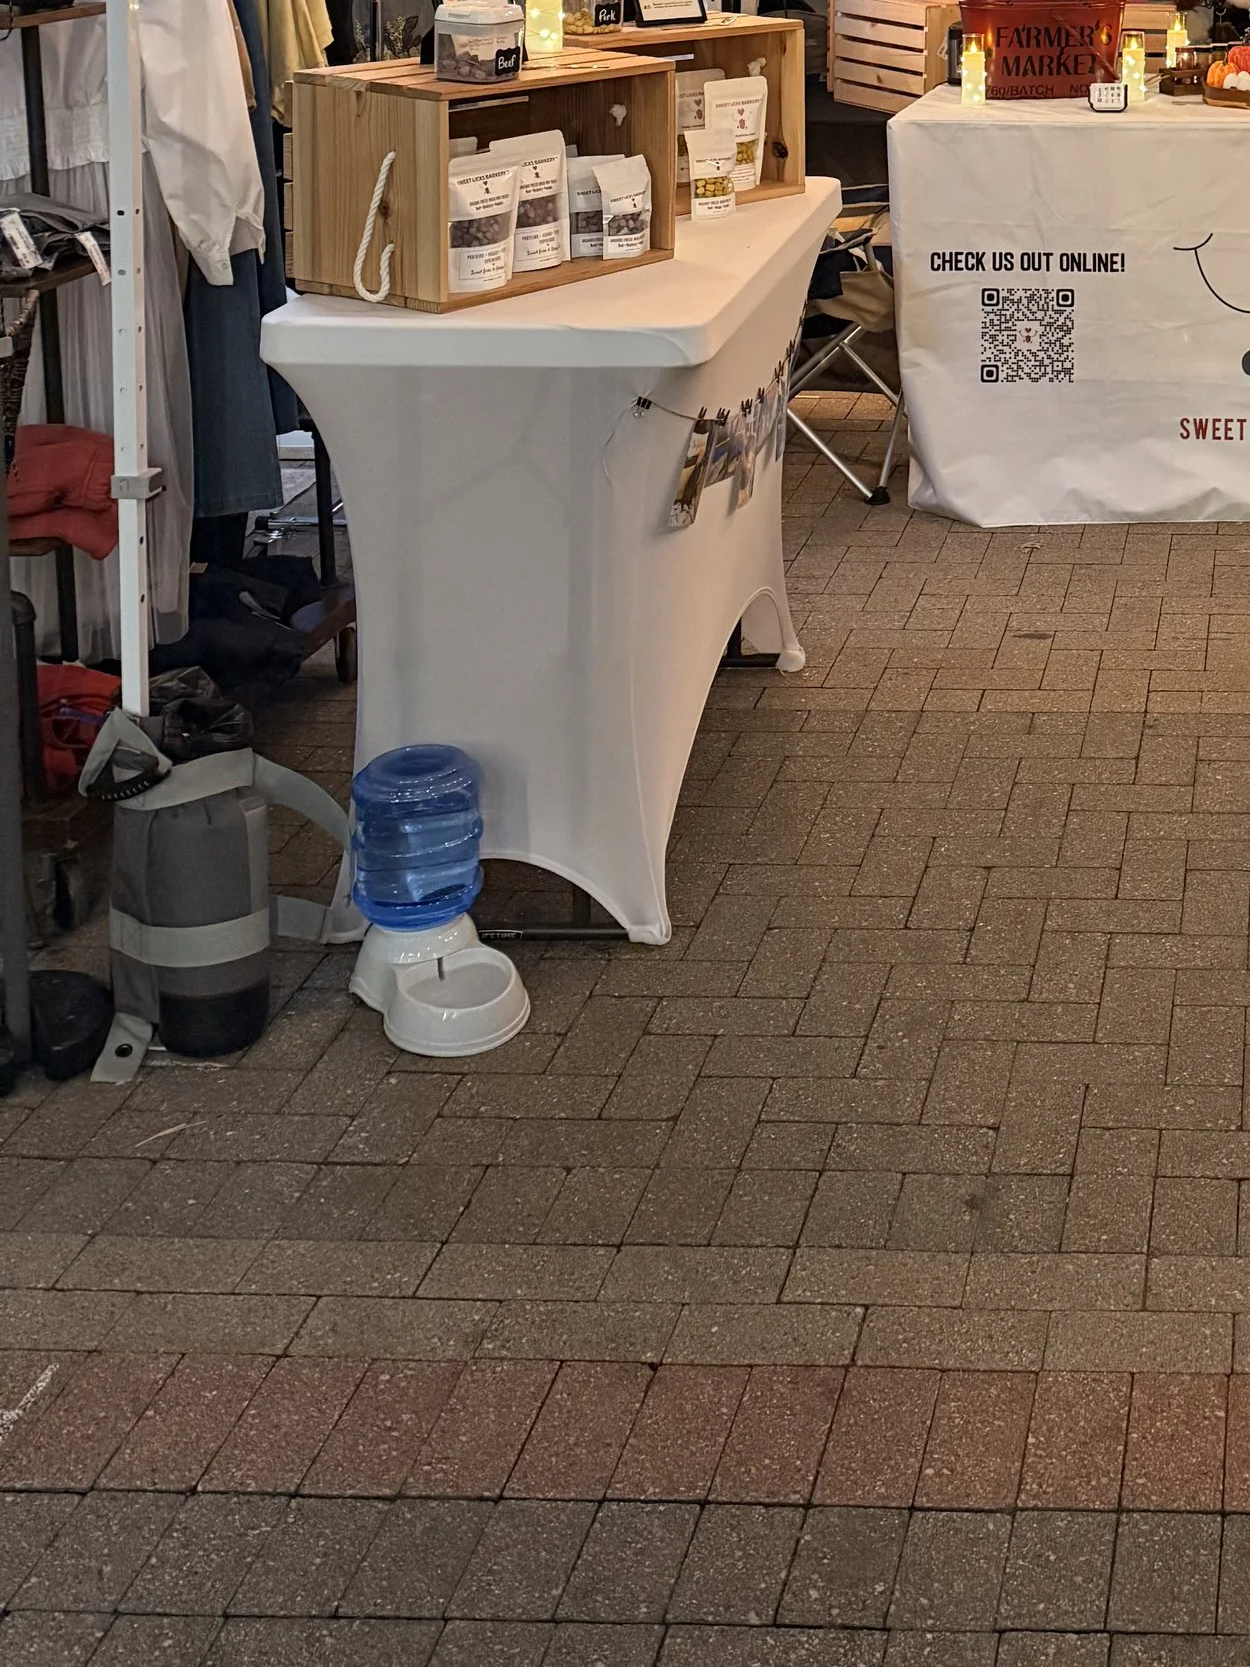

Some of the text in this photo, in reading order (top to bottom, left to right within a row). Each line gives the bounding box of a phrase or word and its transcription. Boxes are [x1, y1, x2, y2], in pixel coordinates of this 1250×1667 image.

[599, 9, 616, 22] Pork
[996, 21, 1112, 49] FARMER'S
[498, 54, 517, 70] Beef
[1001, 47, 1097, 77] MARKET
[930, 251, 1126, 274] CHECK US OUT ONLINE!
[1179, 417, 1247, 442] SWEET
